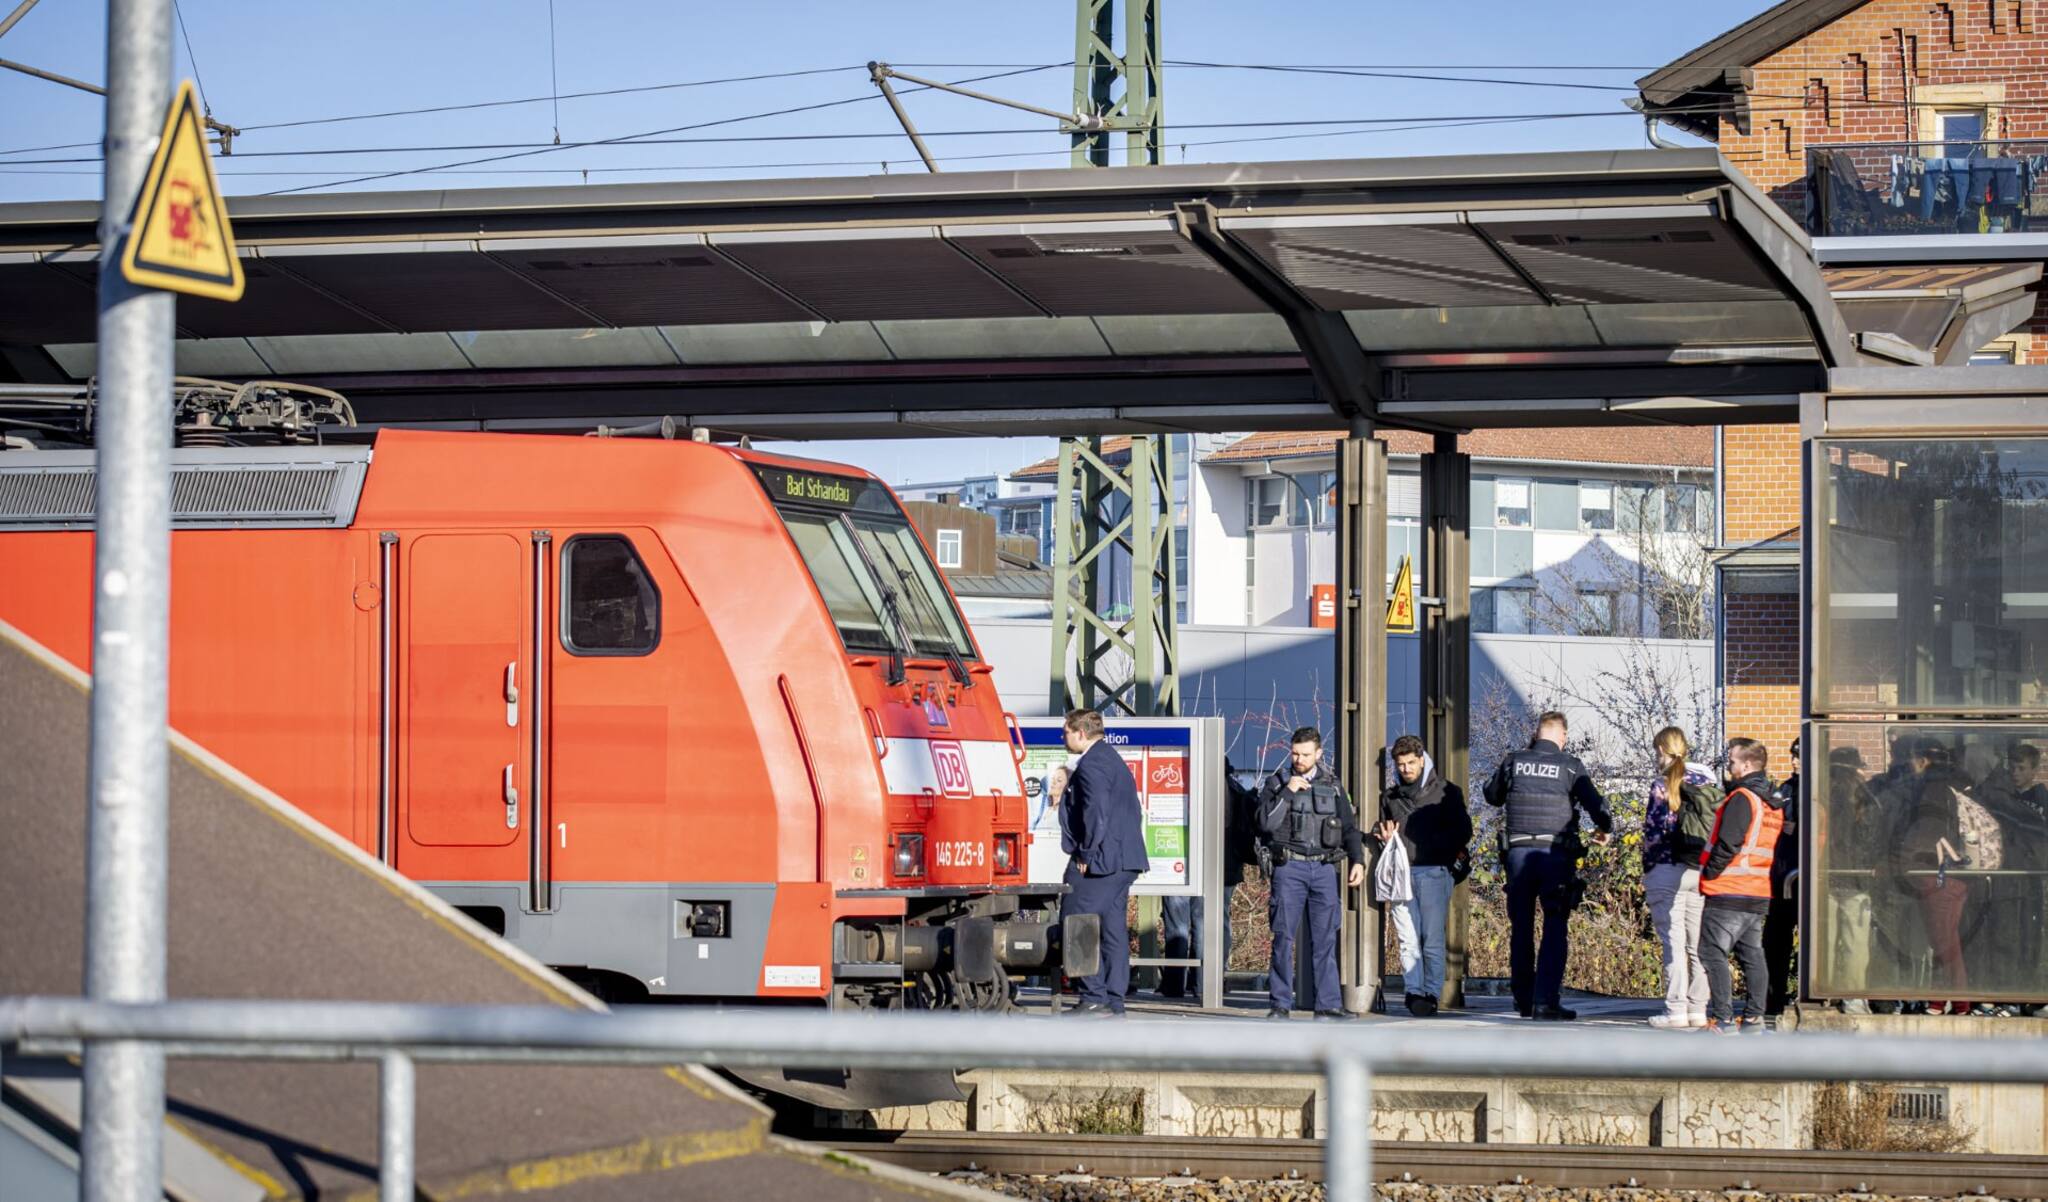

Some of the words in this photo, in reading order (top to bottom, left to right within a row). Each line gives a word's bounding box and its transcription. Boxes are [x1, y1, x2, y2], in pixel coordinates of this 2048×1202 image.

[787, 475, 804, 497] Bad
[807, 478, 849, 502] Schandau
[938, 752, 965, 787] DB
[1515, 762, 1560, 779] POLIZEI
[558, 823, 566, 848] 1
[936, 841, 952, 867] 146
[954, 841, 984, 867] 225-8
